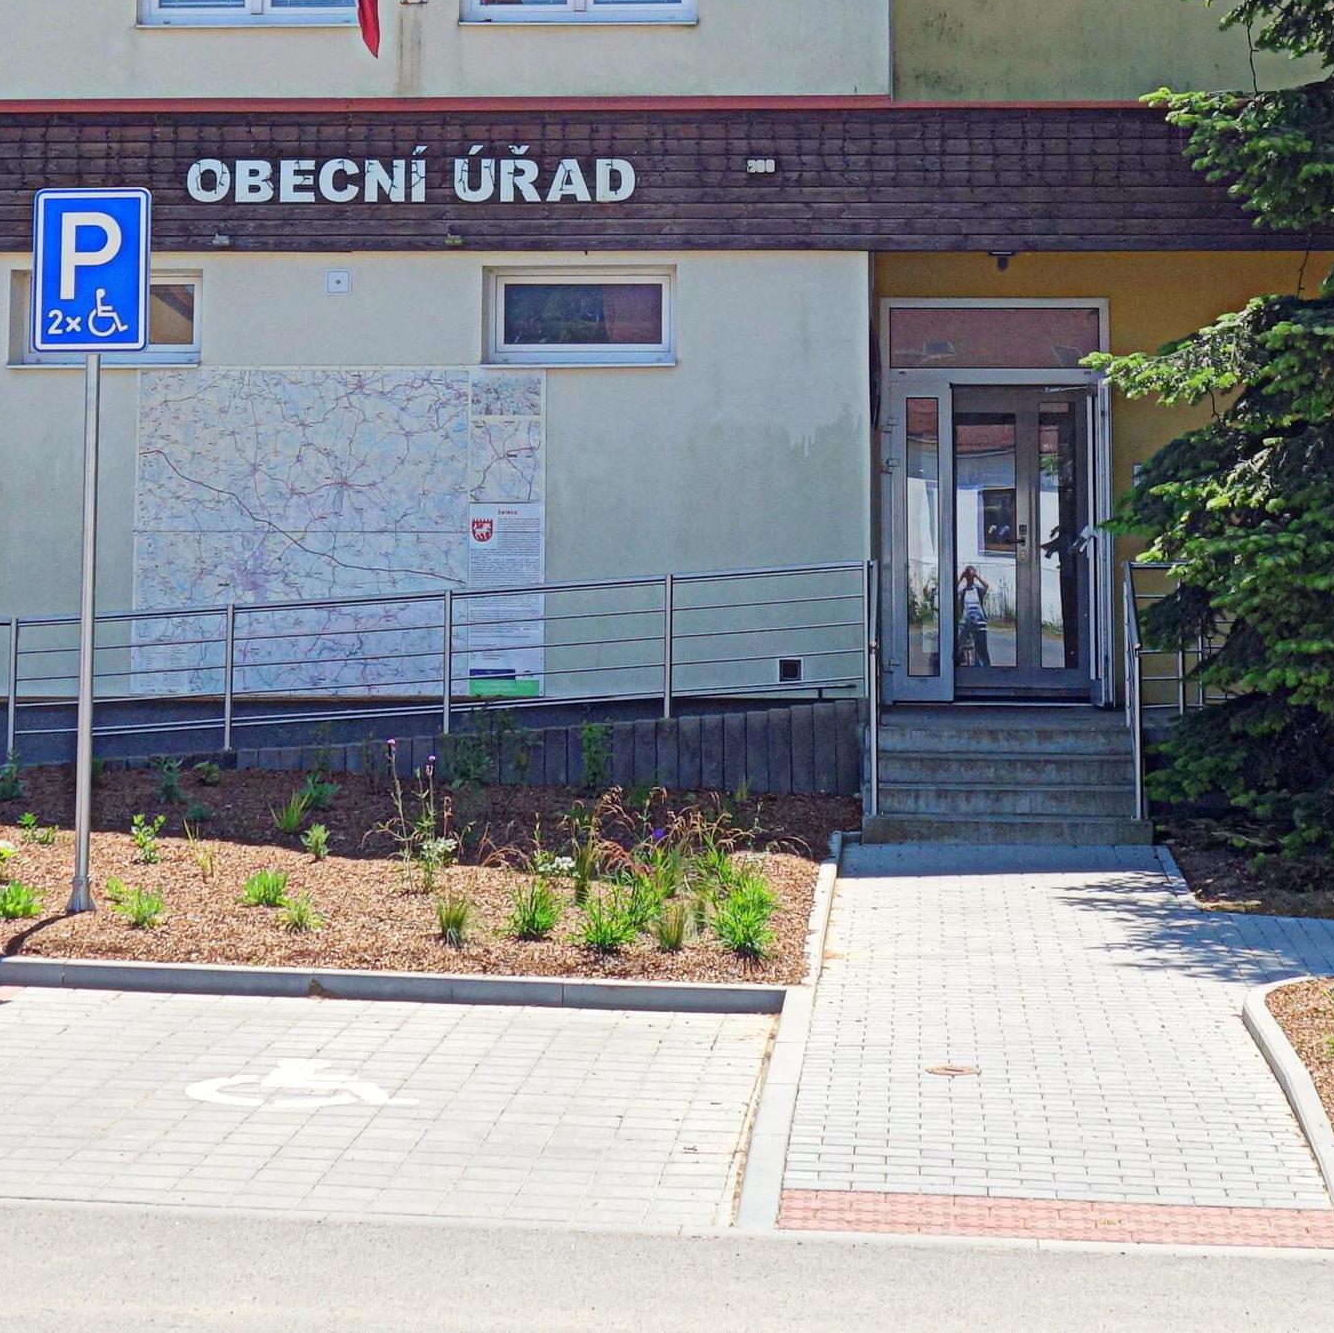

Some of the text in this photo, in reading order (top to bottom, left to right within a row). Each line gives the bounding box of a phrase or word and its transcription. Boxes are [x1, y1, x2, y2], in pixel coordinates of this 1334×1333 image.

[186, 144, 636, 204] OBECNÍ ÚŘAD
[60, 211, 122, 300] P
